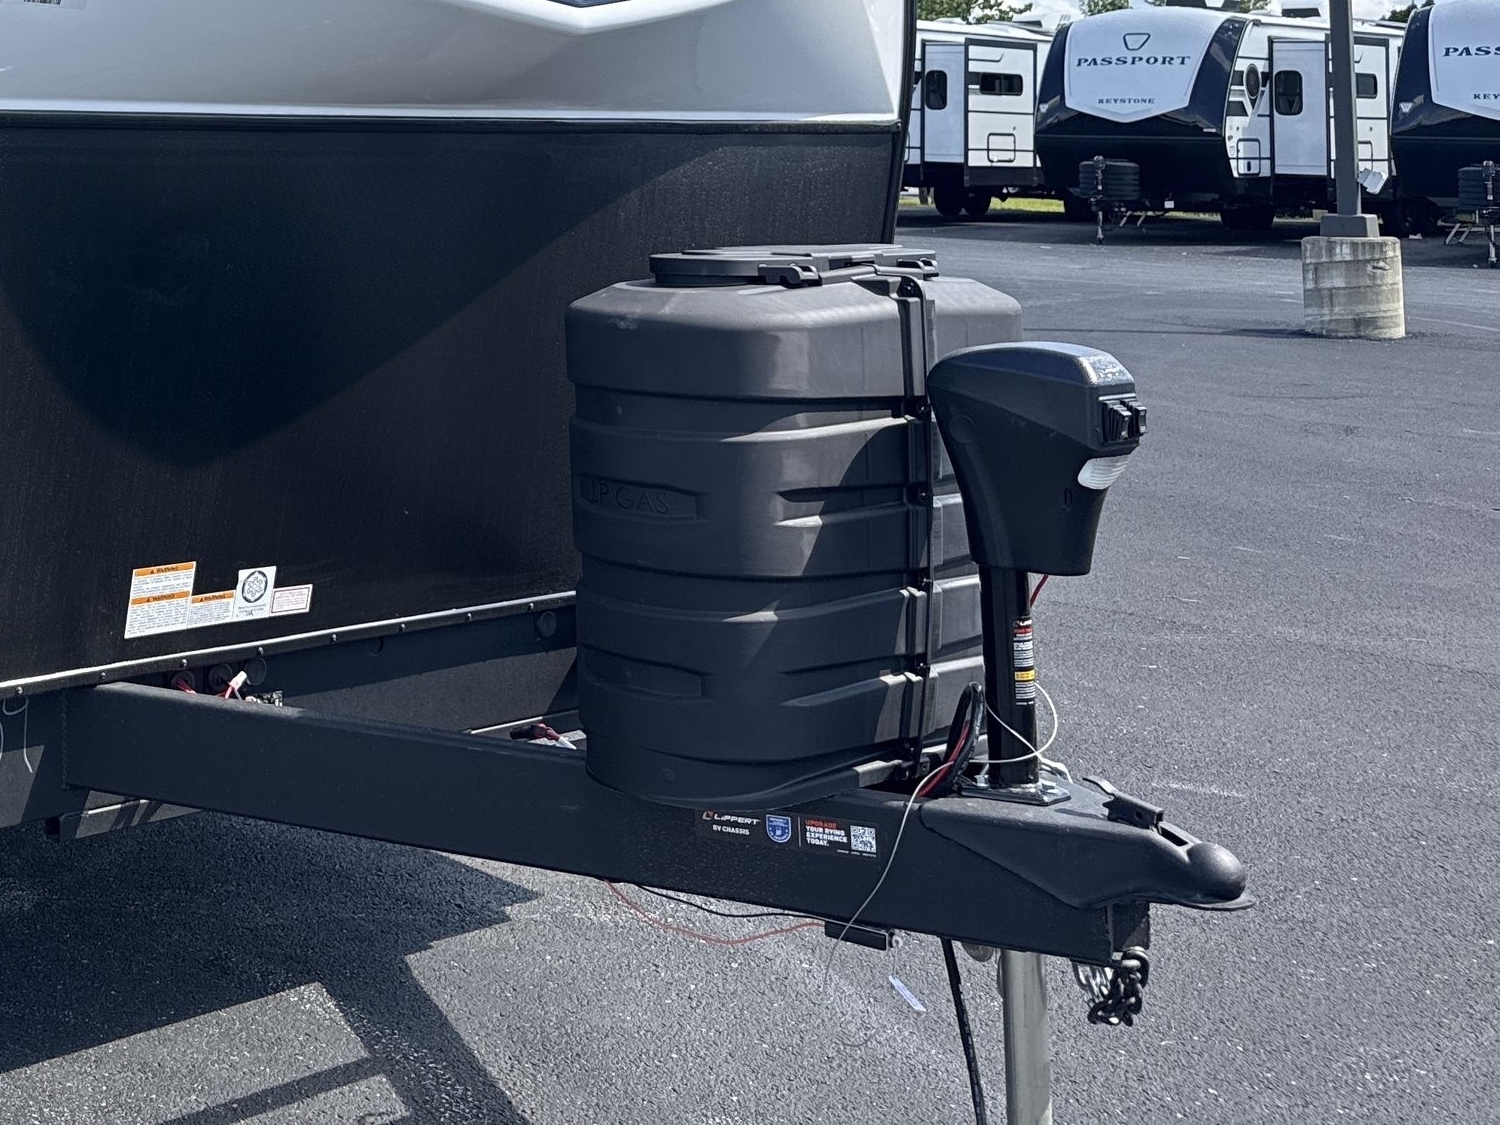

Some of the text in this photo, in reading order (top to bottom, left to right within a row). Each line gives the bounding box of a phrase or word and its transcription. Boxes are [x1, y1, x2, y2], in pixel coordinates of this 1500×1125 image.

[1076, 55, 1191, 67] PASSPORT
[1098, 97, 1156, 105] KEYSTONE
[615, 486, 670, 515] GAS
[714, 813, 762, 826] LIPPERT
[722, 825, 750, 836] CHASSIS
[806, 826, 845, 836] YOUR RVING
[806, 832, 848, 843] EXPERIENCE
[806, 838, 830, 847] TODAY.
